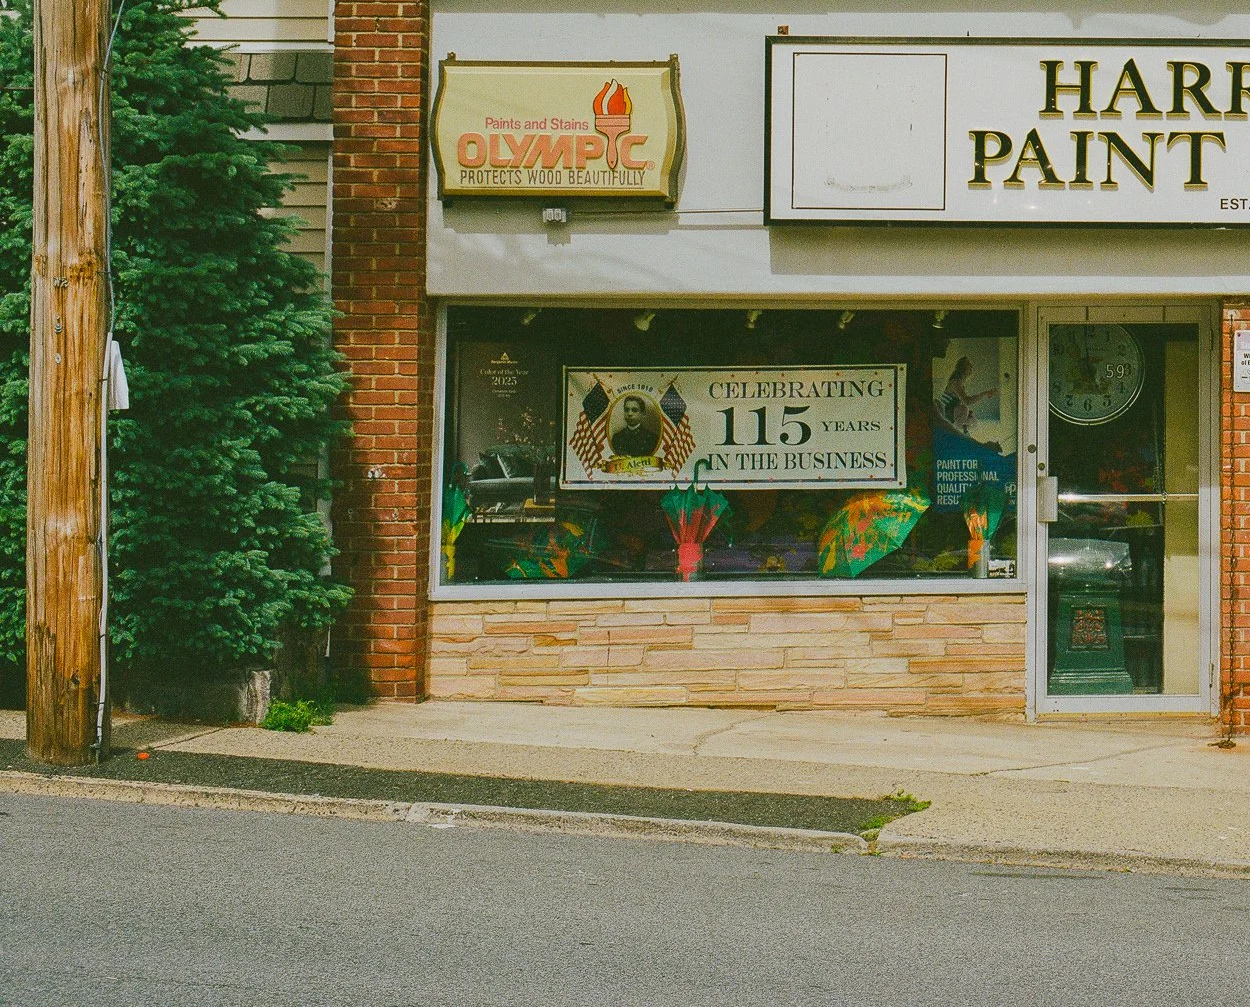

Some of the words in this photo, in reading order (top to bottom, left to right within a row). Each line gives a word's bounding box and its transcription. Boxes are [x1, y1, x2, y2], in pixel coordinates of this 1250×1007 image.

[485, 117, 521, 130] Paints
[524, 117, 547, 130] and
[550, 117, 589, 130] Stains
[967, 128, 1226, 192] PAINT
[460, 170, 522, 185] PROTECTS
[527, 170, 563, 185] WOOD
[568, 170, 646, 186] BEAUTIFULLY
[1106, 364, 1124, 379] 59
[491, 376, 518, 386] 2025
[617, 384, 635, 394] SINCE
[708, 380, 885, 400] CELEBRATING
[715, 405, 812, 446] 115
[822, 420, 882, 432] YEARS
[707, 453, 730, 470] IN
[735, 452, 778, 470] THE
[784, 451, 887, 470] BUSINESS
[937, 459, 961, 470] PAINT
[962, 459, 978, 469] FOR
[937, 471, 999, 482] PROFESSINAL
[937, 495, 962, 505] RESU
